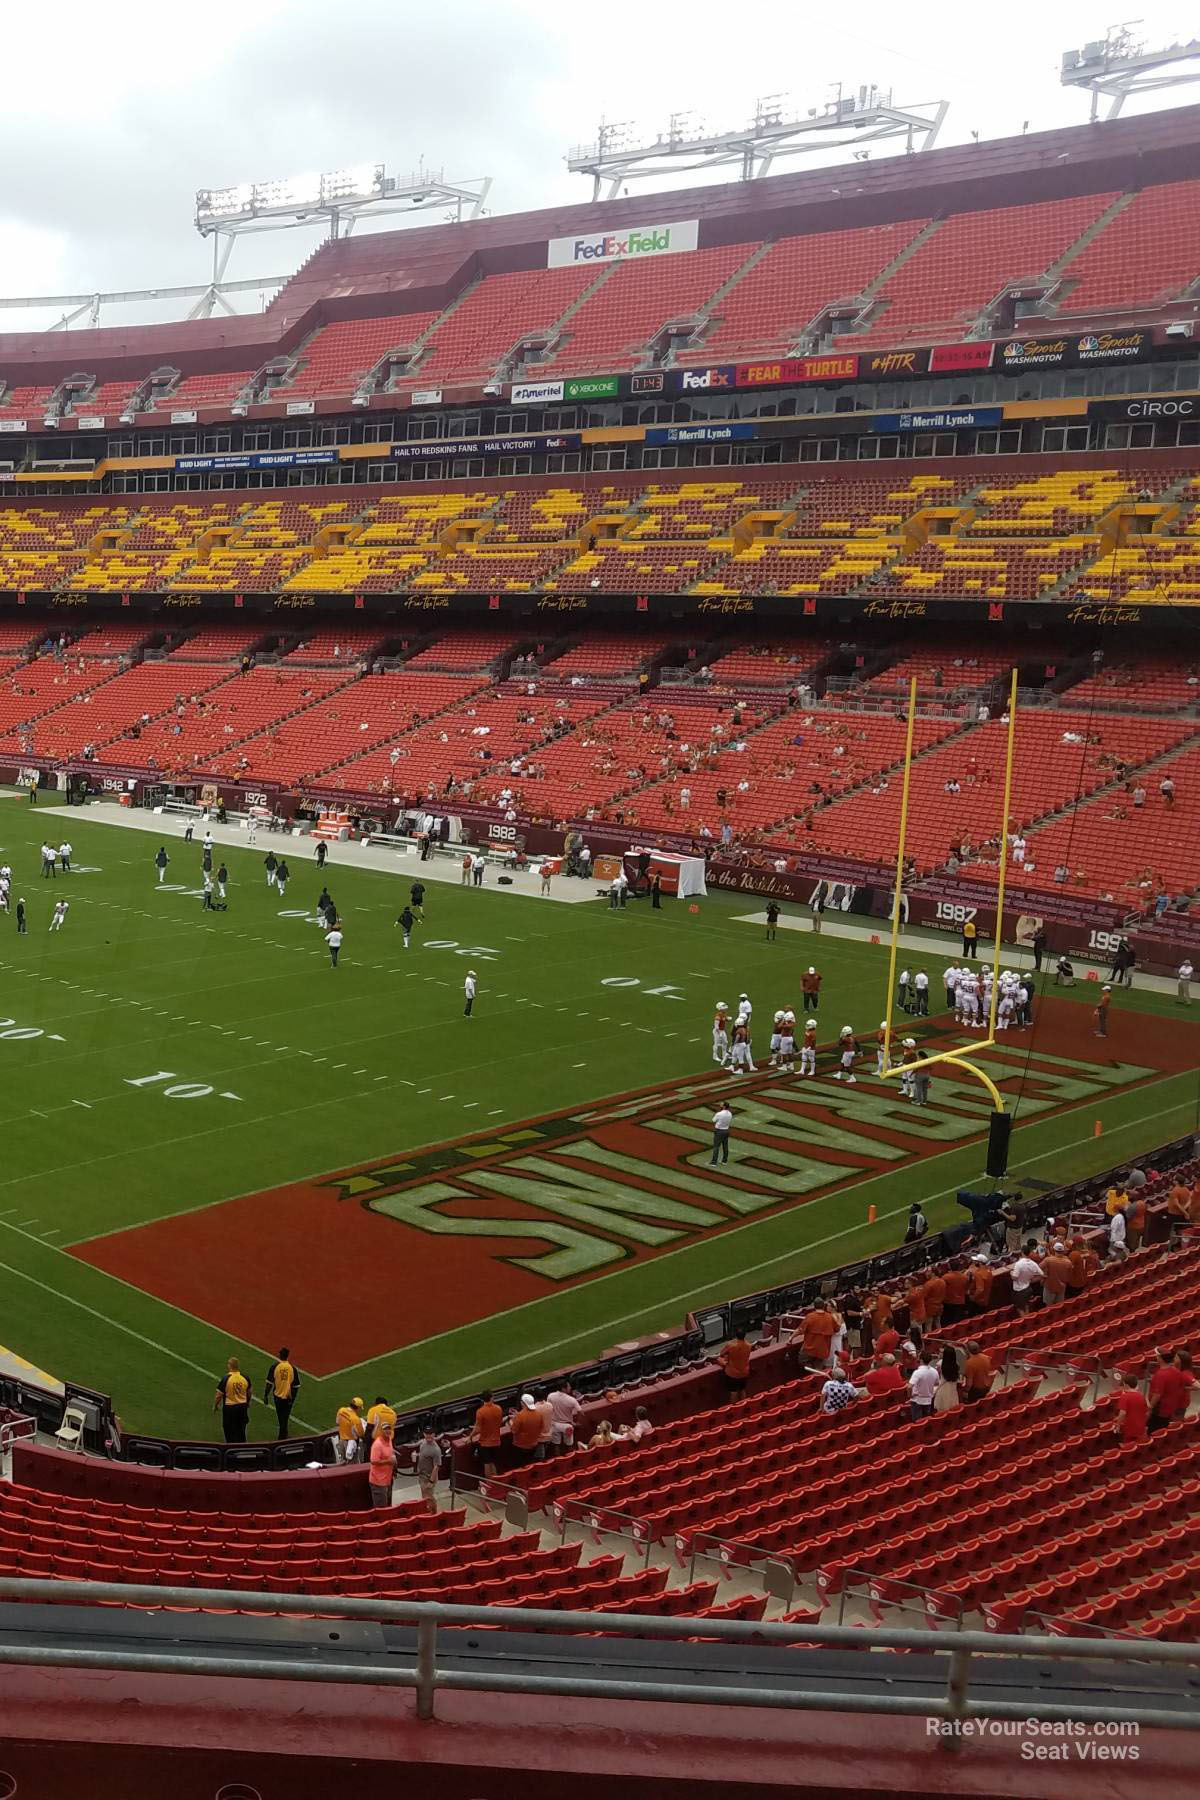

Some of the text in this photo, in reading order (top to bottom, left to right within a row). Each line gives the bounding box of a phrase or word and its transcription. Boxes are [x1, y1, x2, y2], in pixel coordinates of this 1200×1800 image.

[573, 229, 671, 260] FedExField
[1022, 340, 1067, 354] Sports
[1097, 333, 1145, 347] Sports
[1005, 353, 1063, 365] WASHINGTON
[1079, 347, 1139, 359] WASHINGTON
[683, 368, 729, 388] FedEx
[579, 382, 614, 393] XBOX ONE
[1127, 400, 1193, 417] CÎROC
[912, 413, 974, 427] Merrill Lynch
[679, 427, 732, 440] Merrill Lynch
[395, 448, 410, 457] HAIL
[411, 447, 421, 456] TO
[422, 445, 457, 455] REDSKINS
[485, 442, 500, 451] HAIL
[502, 440, 536, 450] VICTORY!
[180, 460, 193, 468] BUD
[194, 458, 213, 468] LIGHT
[259, 456, 273, 464] BUD
[274, 454, 294, 464] LIGHT
[103, 778, 124, 792] 1942
[245, 791, 267, 806] 1972
[488, 824, 517, 841] 1982
[718, 869, 737, 886] the
[935, 901, 978, 923] 1987
[122, 1070, 214, 1099] 10
